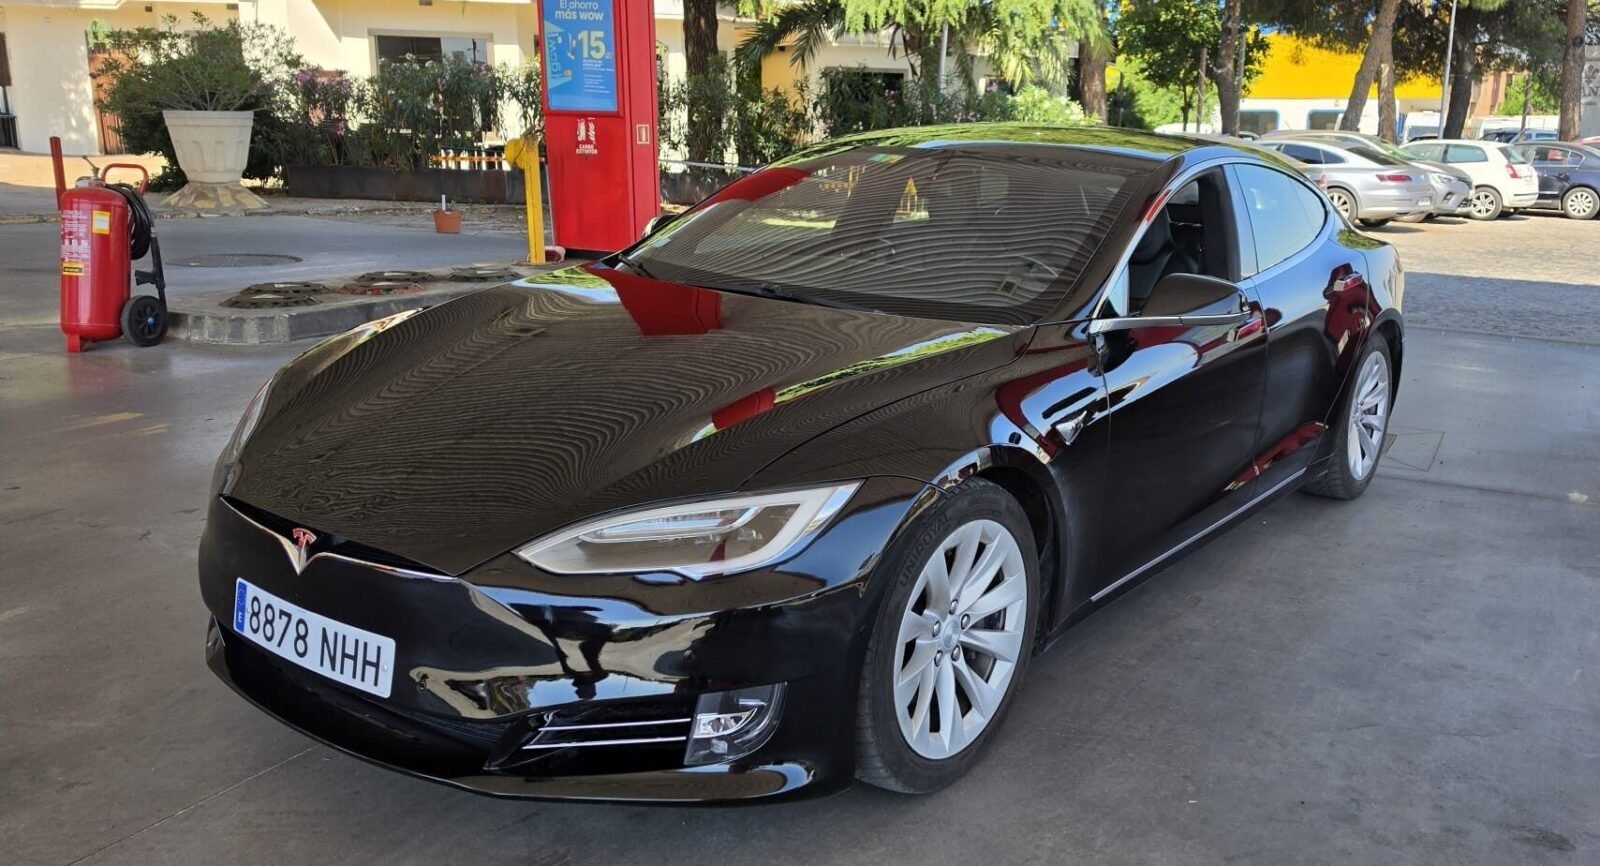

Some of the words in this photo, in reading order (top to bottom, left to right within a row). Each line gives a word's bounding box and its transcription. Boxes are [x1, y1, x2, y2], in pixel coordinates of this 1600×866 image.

[555, 8, 577, 19] más
[579, 11, 604, 20] wow
[560, 0, 567, 8] El
[569, 0, 599, 9] ahorro
[578, 30, 606, 59] 15
[899, 513, 952, 586] UNIROYAL
[238, 611, 244, 623] E
[249, 595, 309, 658] 8878
[320, 627, 381, 687] NHH
